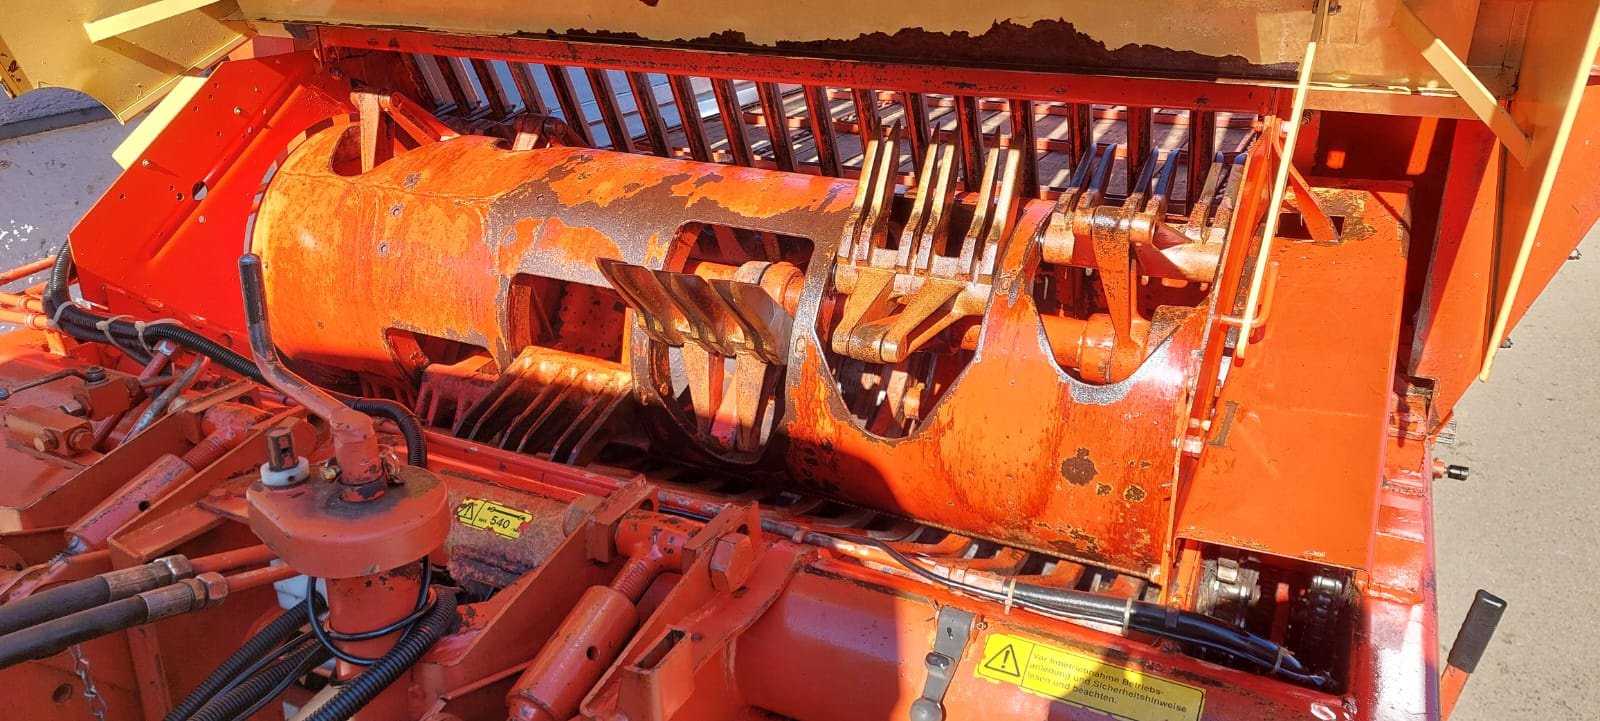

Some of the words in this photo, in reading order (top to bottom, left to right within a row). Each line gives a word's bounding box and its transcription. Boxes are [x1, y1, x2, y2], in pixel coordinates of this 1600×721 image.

[490, 516, 510, 529] 540
[1027, 671, 1051, 684] lesen
[1053, 678, 1070, 690] und
[1073, 685, 1117, 704] beachten.
[1029, 663, 1071, 680] anleitung
[1073, 673, 1090, 685] und
[1093, 680, 1187, 713] Sicherheitshinweise
[1033, 654, 1048, 663] Vor
[1122, 679, 1164, 695] Betriebs-
